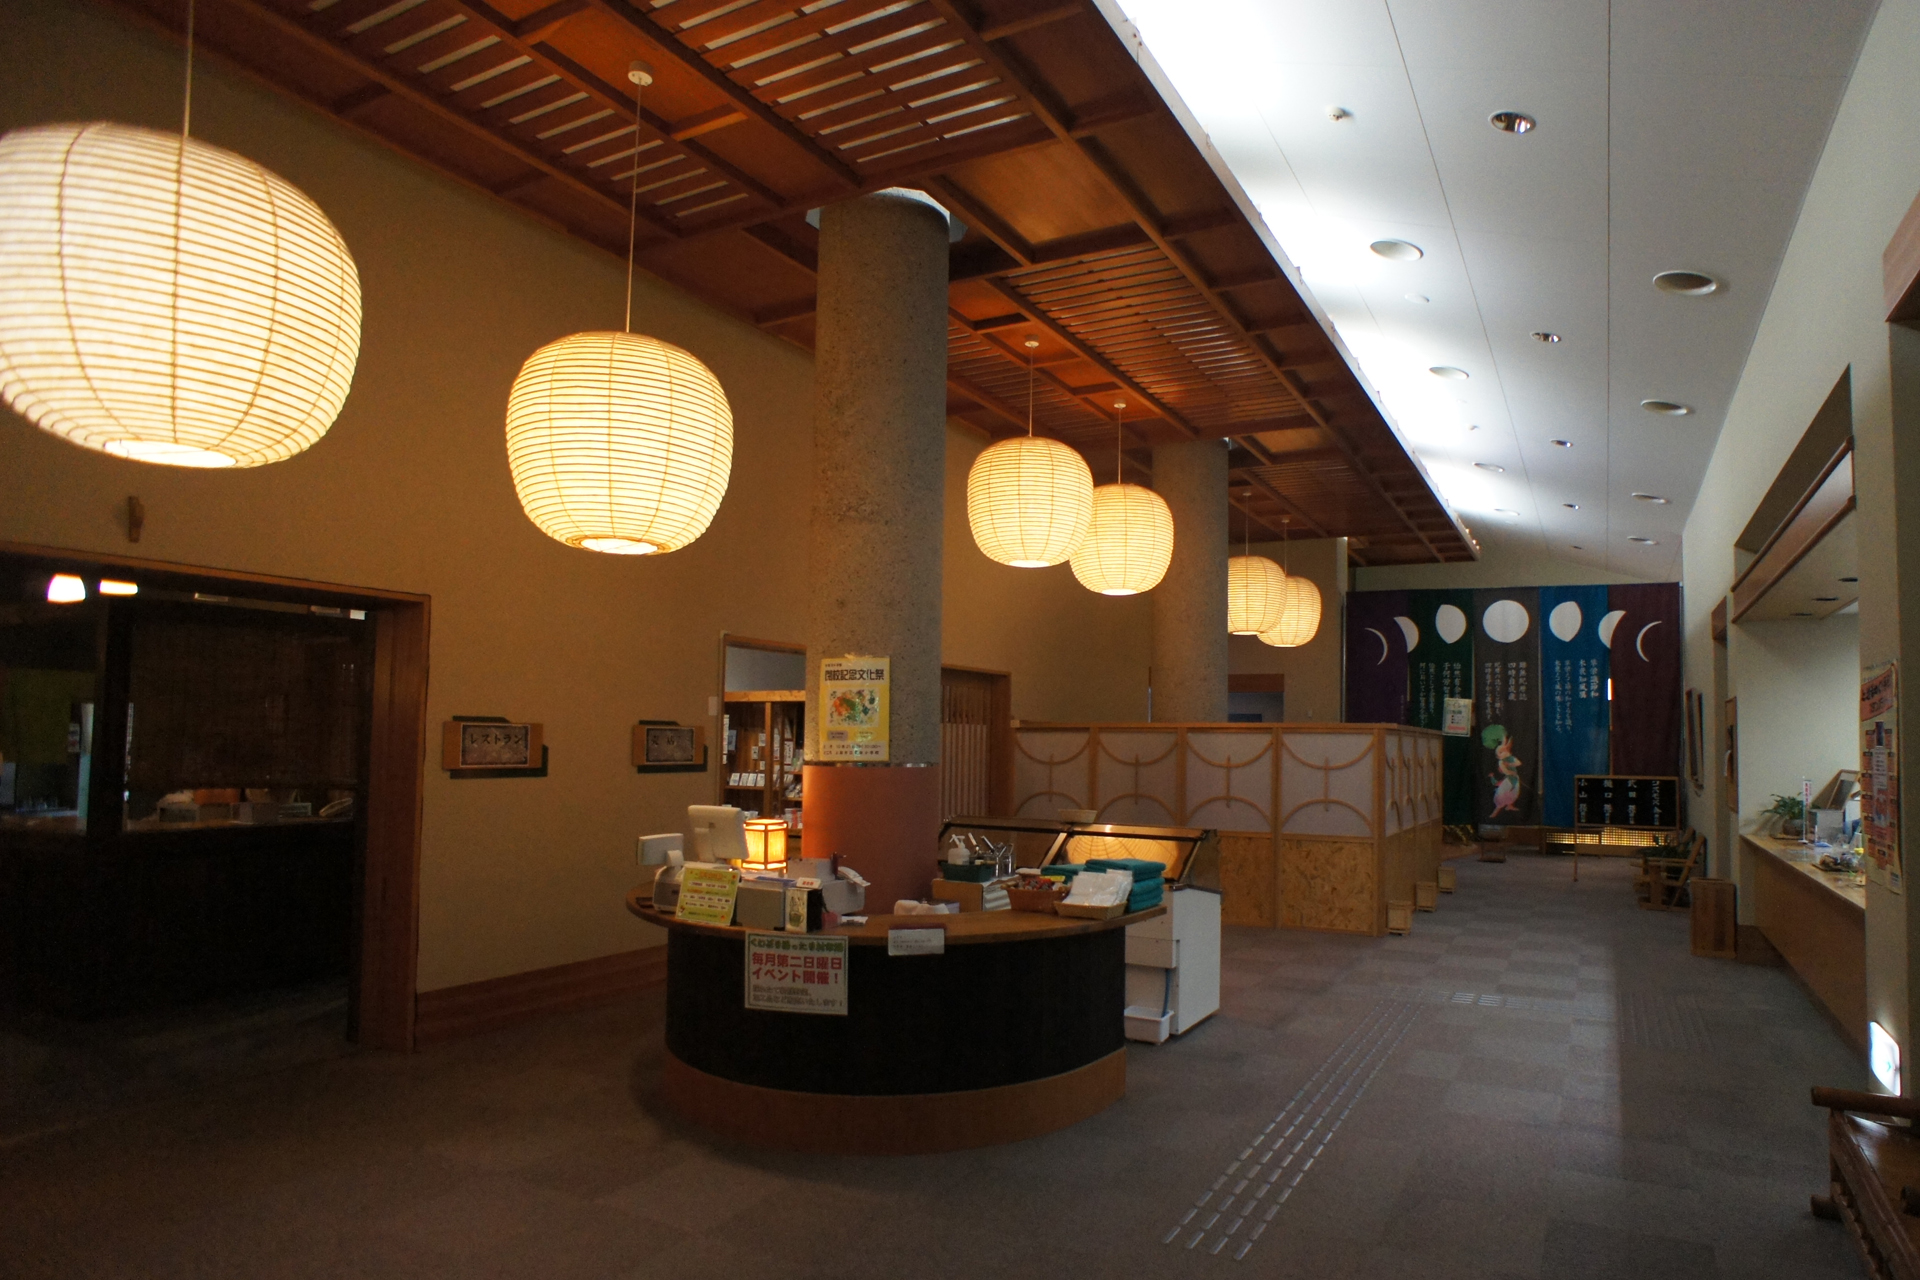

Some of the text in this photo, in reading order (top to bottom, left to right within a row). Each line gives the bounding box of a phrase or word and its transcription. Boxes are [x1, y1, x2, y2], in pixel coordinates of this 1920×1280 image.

[470, 733, 523, 744] レストラン
[752, 952, 842, 970] 毎月第二日曜日
[752, 967, 838, 985] イベント開催！
